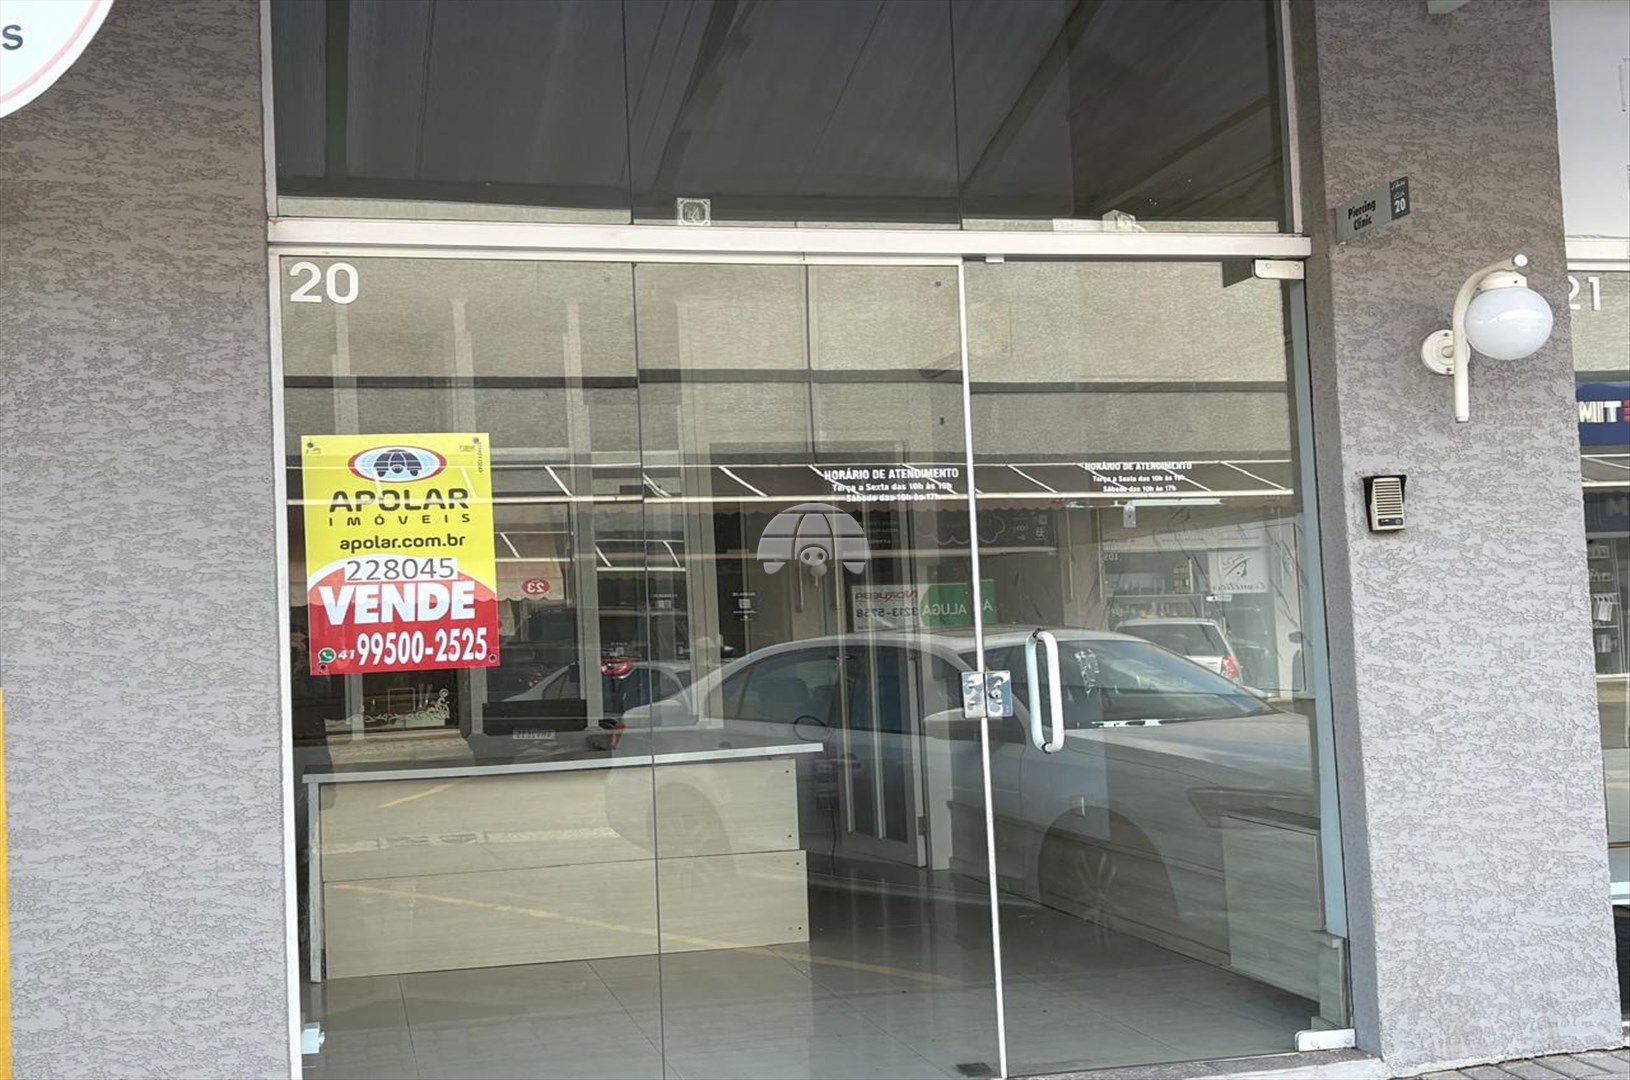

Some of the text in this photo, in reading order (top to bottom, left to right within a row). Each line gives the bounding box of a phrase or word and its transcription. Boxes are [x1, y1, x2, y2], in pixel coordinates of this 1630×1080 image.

[1348, 200, 1376, 220] Piercing
[1394, 198, 1406, 214] 20
[1353, 214, 1372, 231] Clinic
[289, 261, 359, 304] 20
[824, 468, 959, 480] HORÁRIO DE ATENDIMENTO
[1084, 461, 1192, 470] HORÁRIO DE ATENDIMENTO
[832, 484, 857, 493] Terça
[865, 483, 890, 491] Sexta
[891, 482, 907, 490] das
[909, 482, 924, 490] 10h
[1092, 475, 1112, 483] Terça
[1103, 485, 1127, 493] Sábado
[329, 488, 470, 513] APOLAR
[329, 513, 471, 526] IMÓVEIS
[339, 534, 466, 553] apolar.com.br
[346, 558, 455, 581] 228045
[318, 581, 476, 625] VENDE
[338, 627, 488, 665] 41 99500-2525
